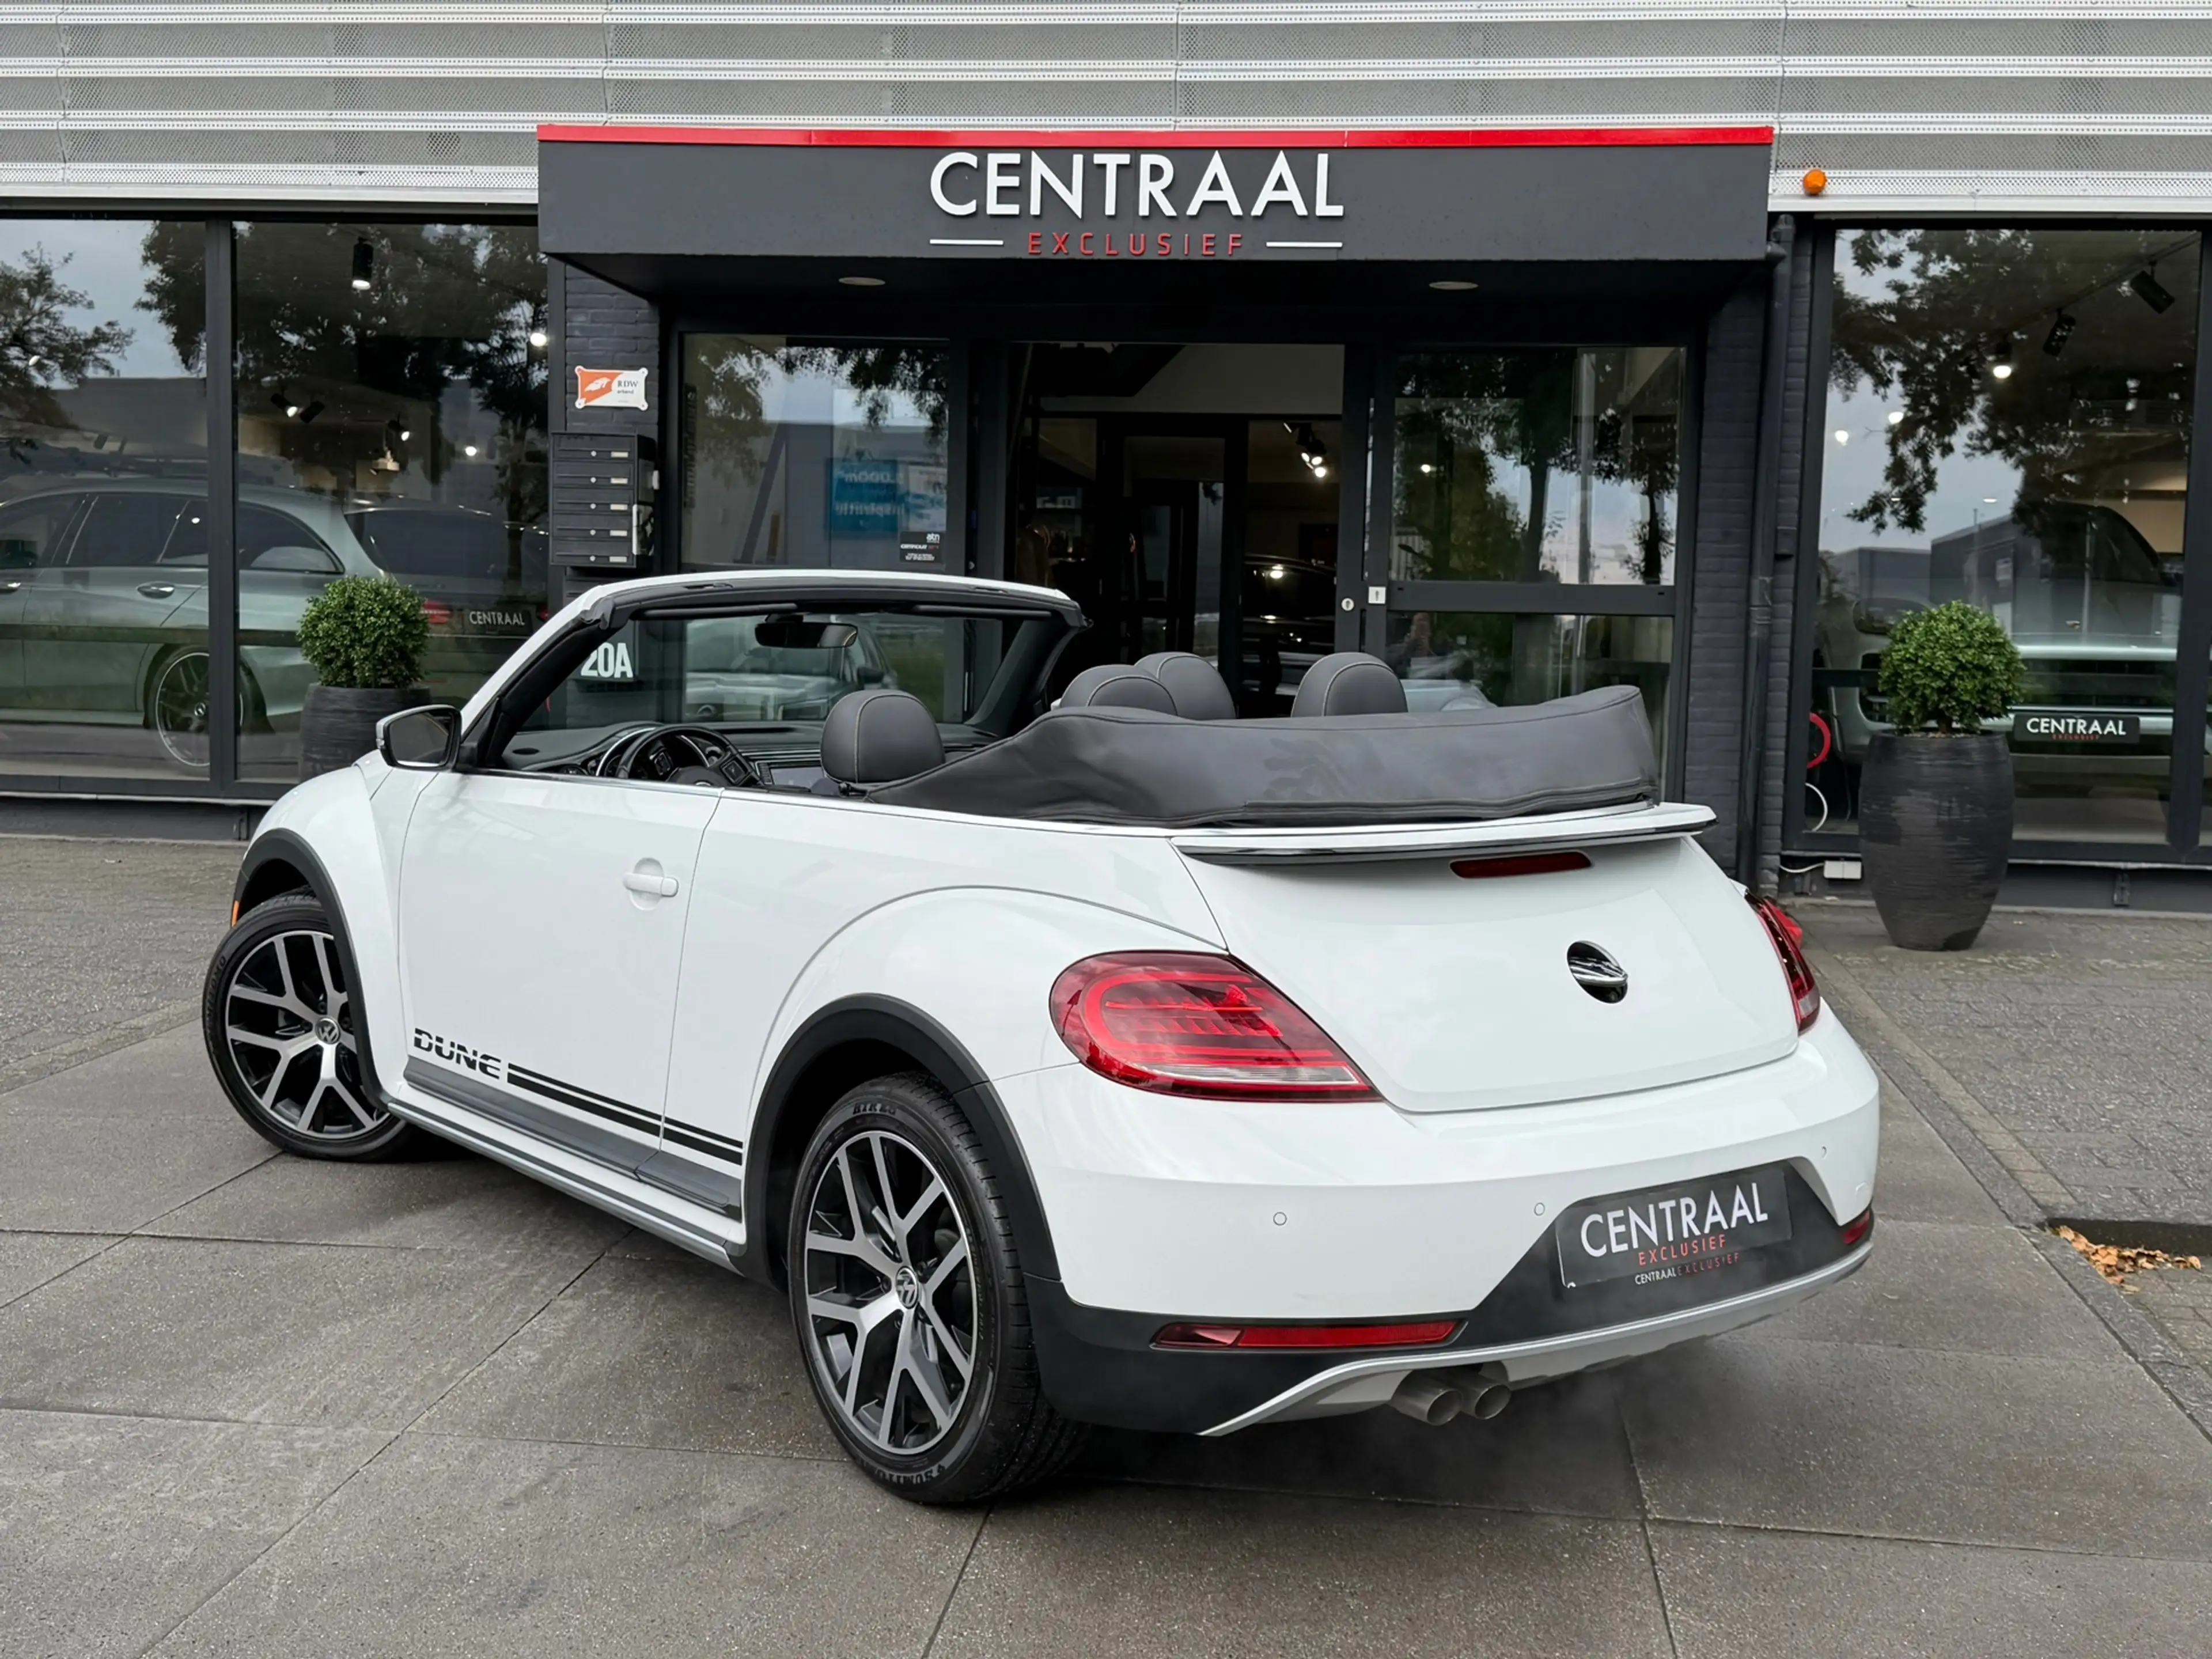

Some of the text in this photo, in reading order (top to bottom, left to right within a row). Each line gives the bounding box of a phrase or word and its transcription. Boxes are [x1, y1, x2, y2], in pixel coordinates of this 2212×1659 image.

[930, 150, 1345, 218] CENTRAAL
[1028, 232, 1244, 256] EXCLUSIEF
[469, 611, 525, 626] CENTRAAL
[2026, 717, 2127, 736] CENTRAAL
[413, 1027, 502, 1080] DUNE
[1581, 1183, 1768, 1257] CENTRAAL
[1638, 1234, 1726, 1266] EXCLUSIEF
